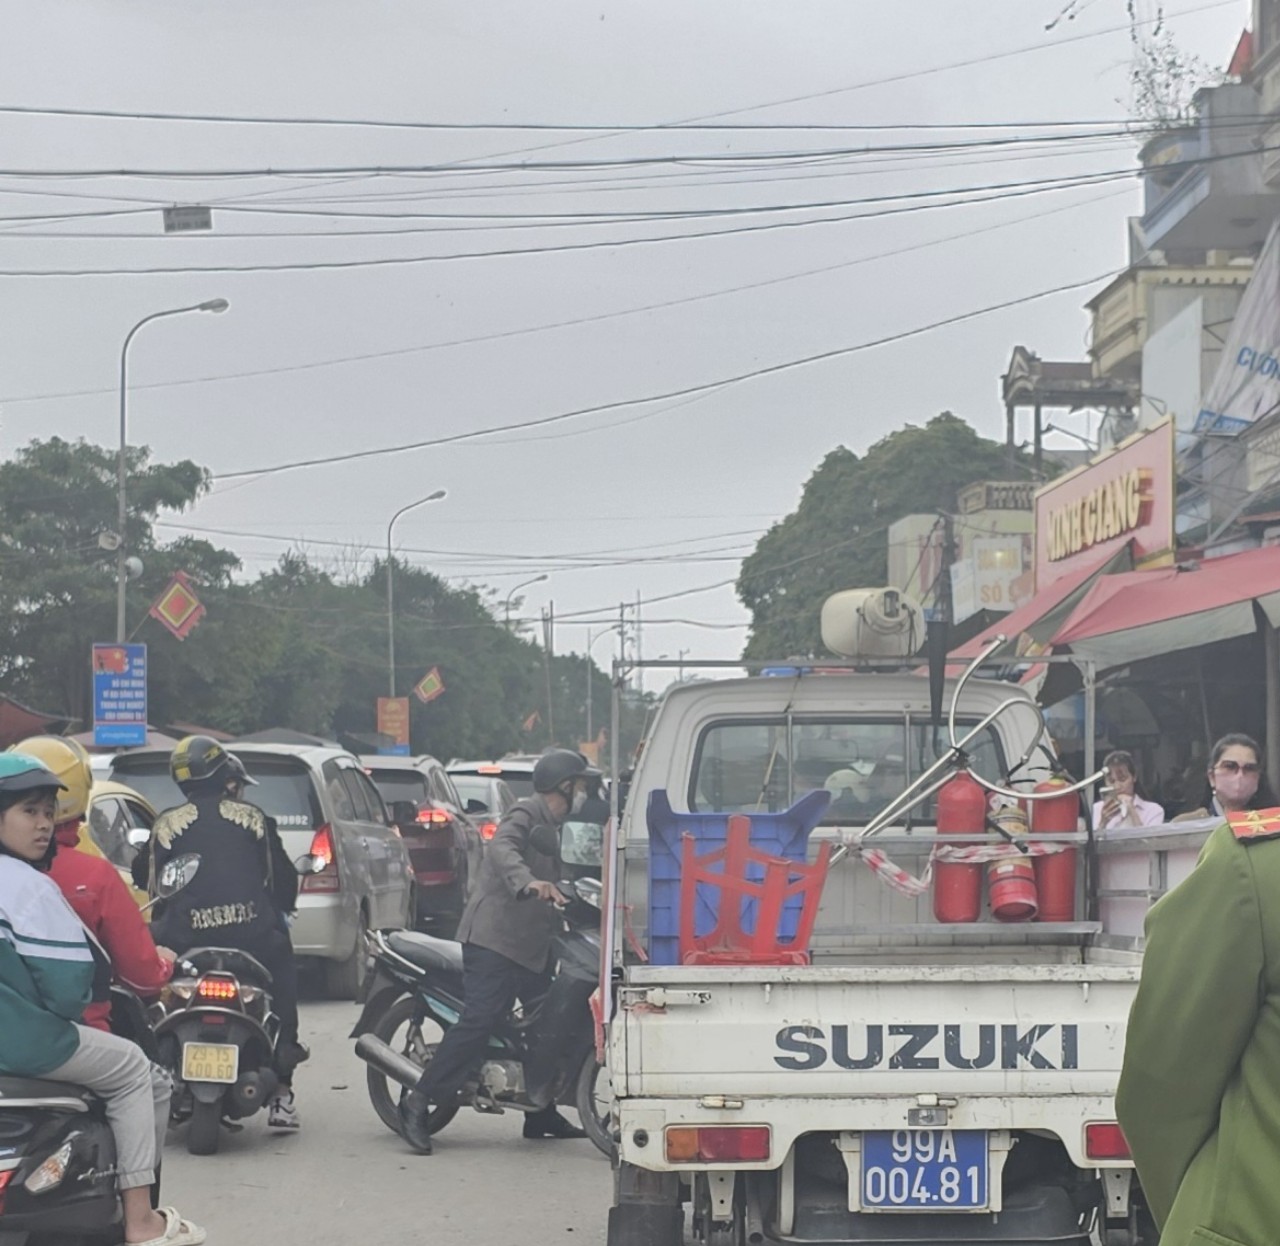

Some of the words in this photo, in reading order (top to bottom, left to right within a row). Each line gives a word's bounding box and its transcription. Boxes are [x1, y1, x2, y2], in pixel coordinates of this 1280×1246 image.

[773, 1024, 1079, 1070] SUZUKI
[892, 1129, 957, 1163] 99A
[866, 1166, 980, 1204] 004.81
